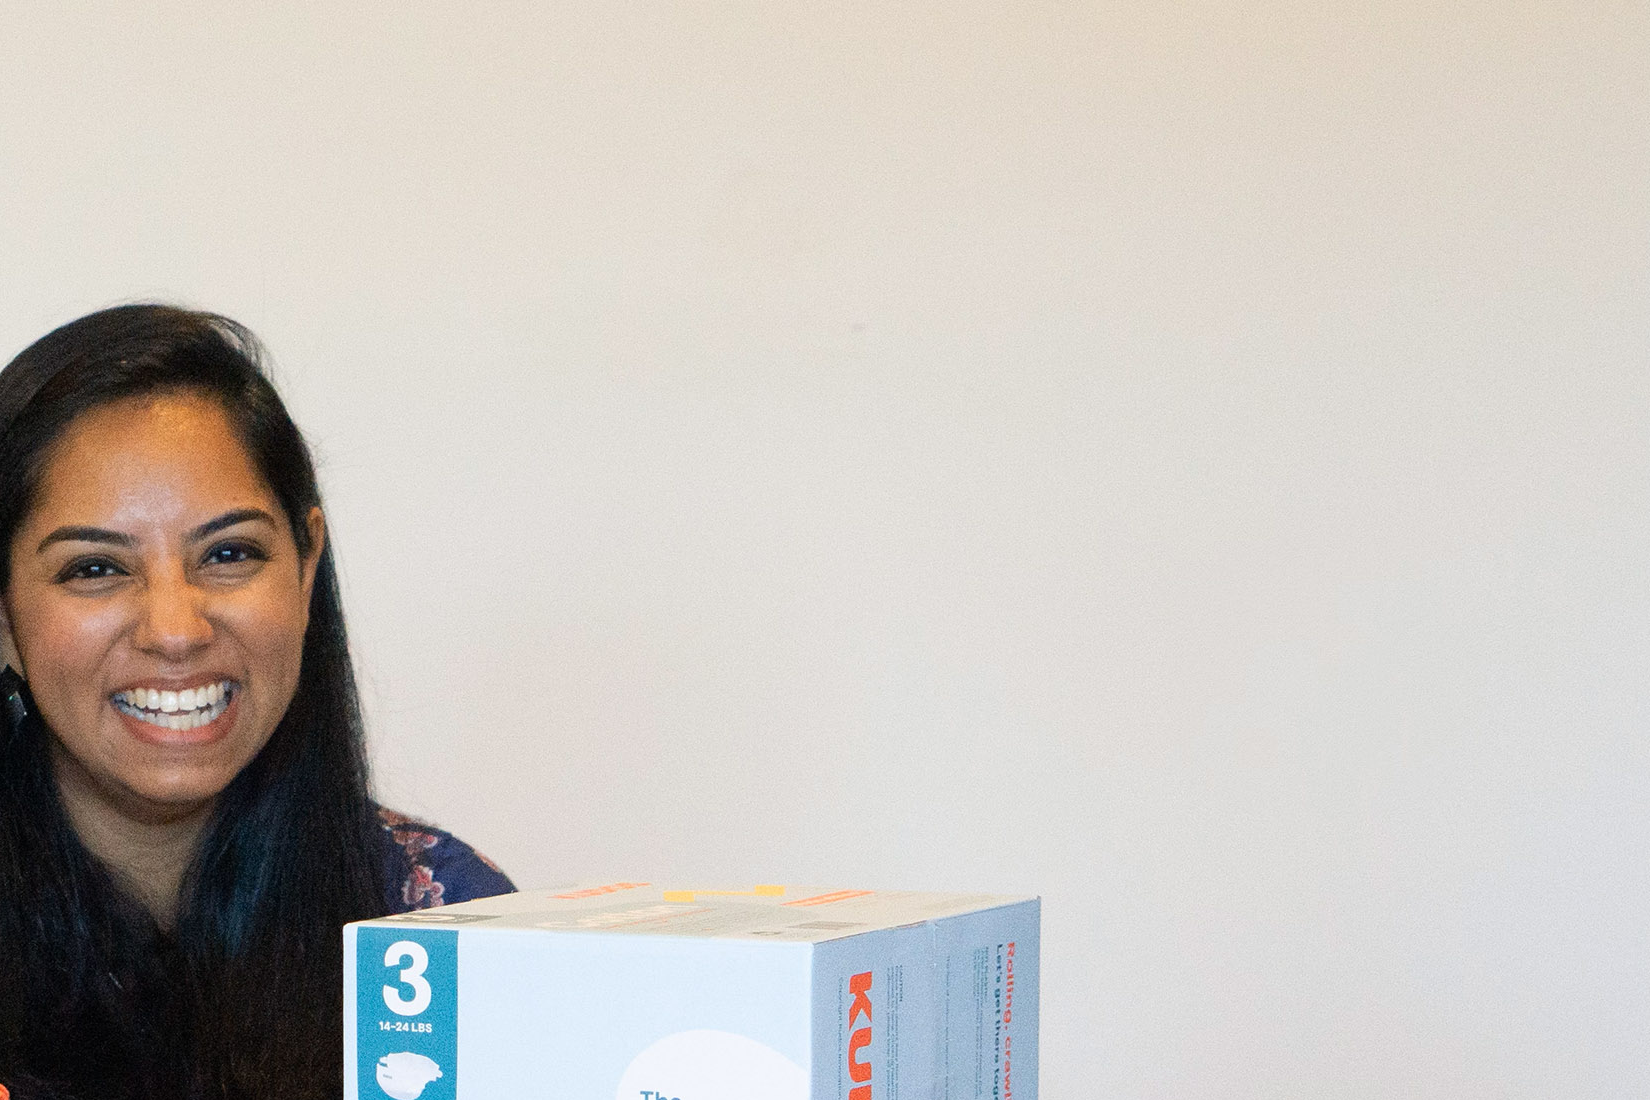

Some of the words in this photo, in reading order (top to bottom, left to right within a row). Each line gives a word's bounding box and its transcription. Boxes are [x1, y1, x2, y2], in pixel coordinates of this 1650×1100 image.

[382, 941, 432, 1016] 3
[379, 1020, 409, 1033] 14-24
[411, 1021, 432, 1033] LBS
